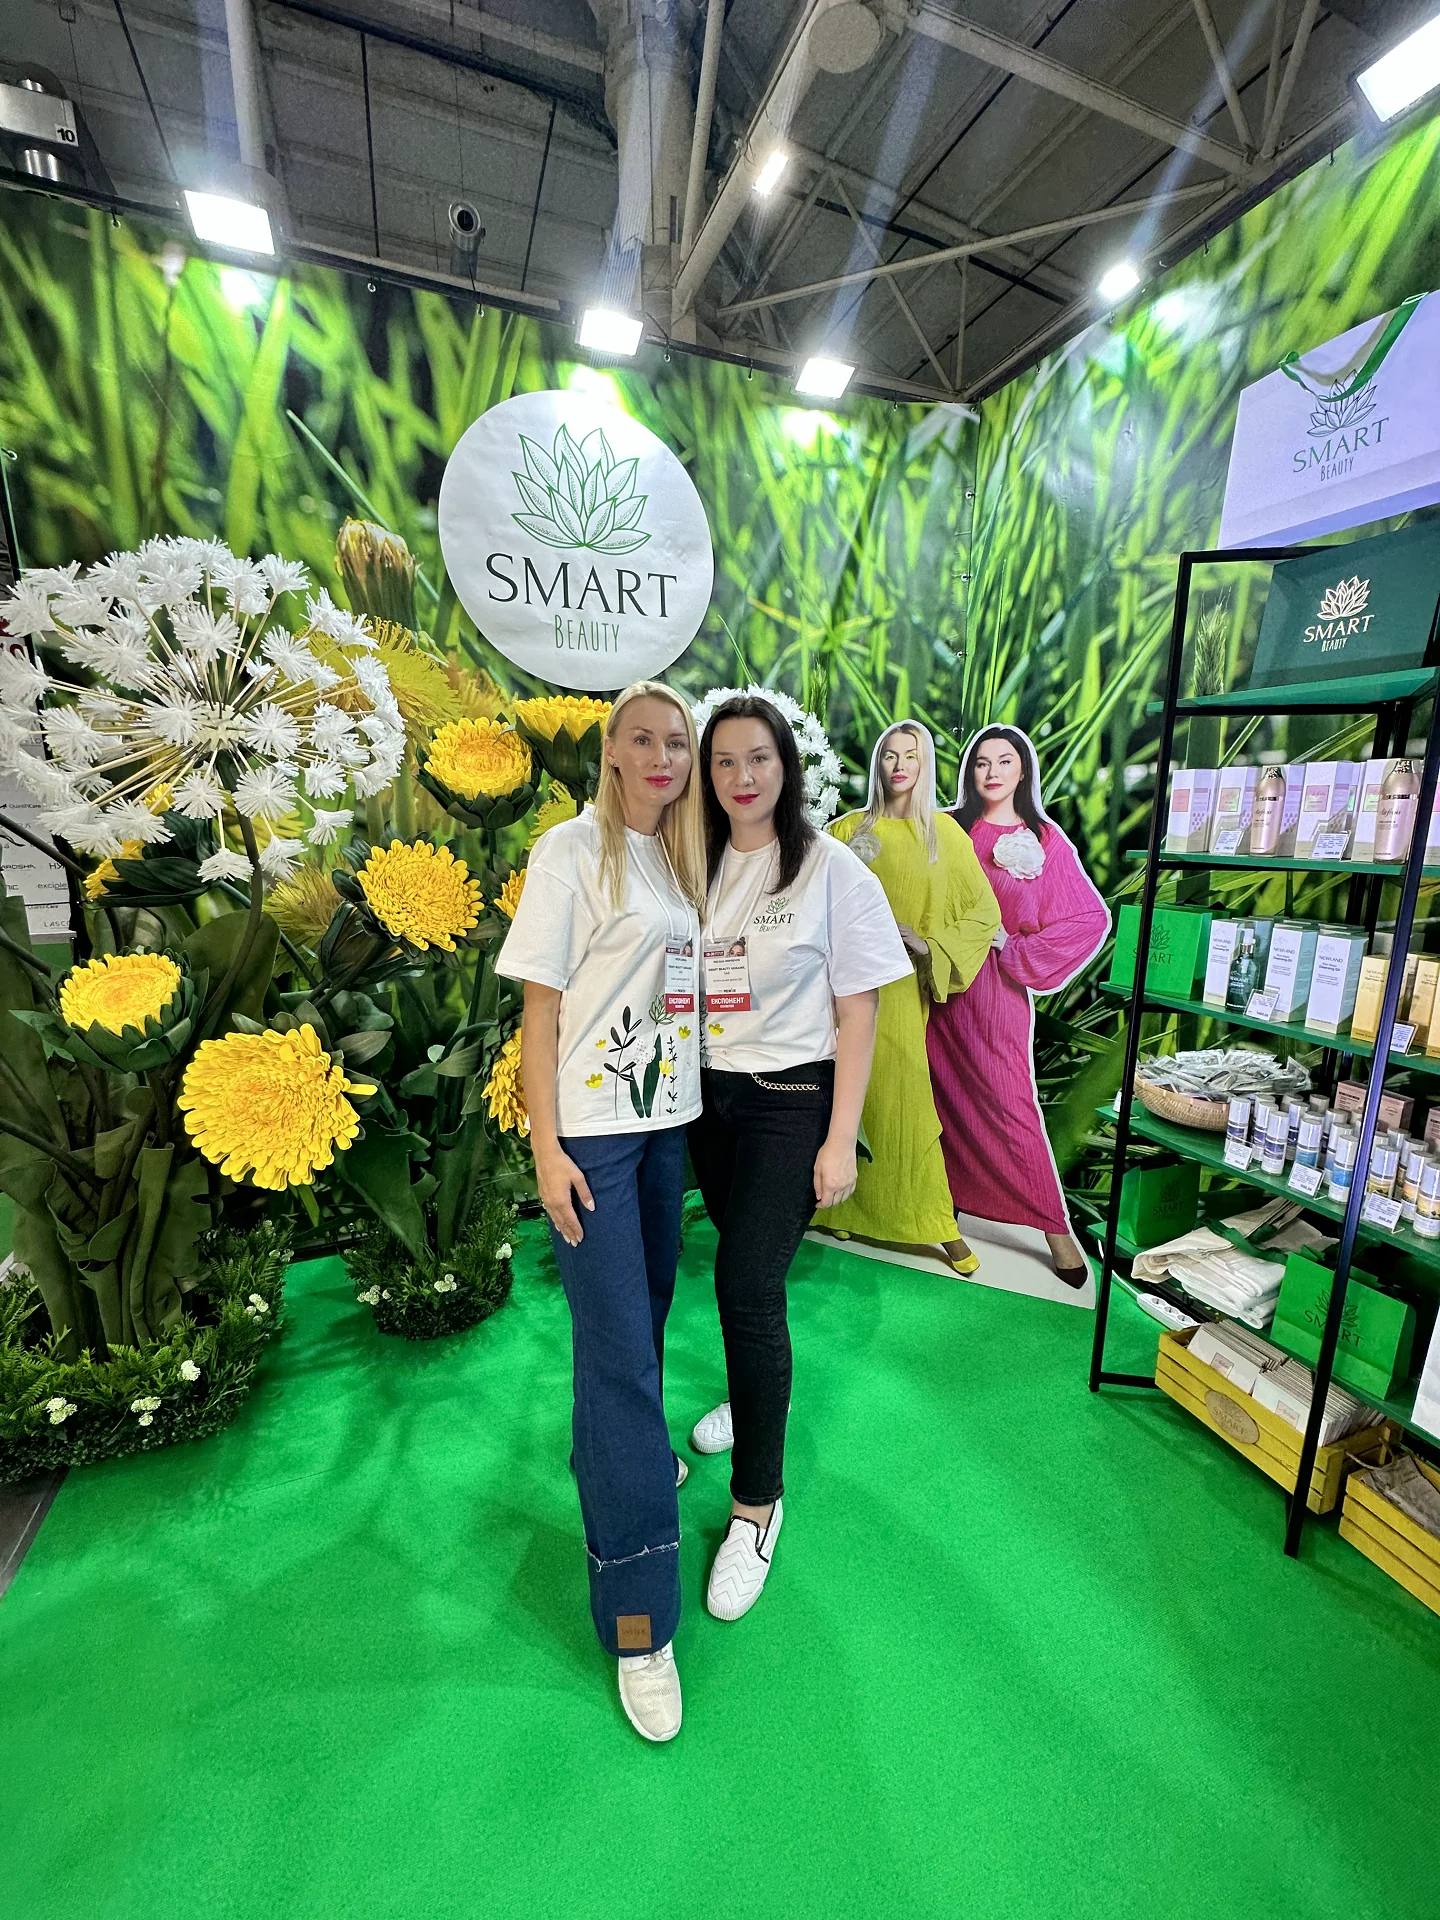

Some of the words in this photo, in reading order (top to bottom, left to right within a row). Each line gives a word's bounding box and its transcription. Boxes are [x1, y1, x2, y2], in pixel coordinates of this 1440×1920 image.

[57, 128, 76, 143] 10
[1292, 417, 1390, 474] SMART
[1320, 456, 1355, 482] BEAUTY
[485, 552, 678, 618] SMART
[554, 614, 621, 652] BEAUTY
[1303, 614, 1375, 643] SMART
[1321, 637, 1347, 652] BEAUTY
[753, 913, 795, 925] SMART
[1132, 948, 1174, 964] SART
[711, 997, 744, 1005] ЕКСПОНЕНТ
[1303, 1310, 1364, 1347] SMRT
